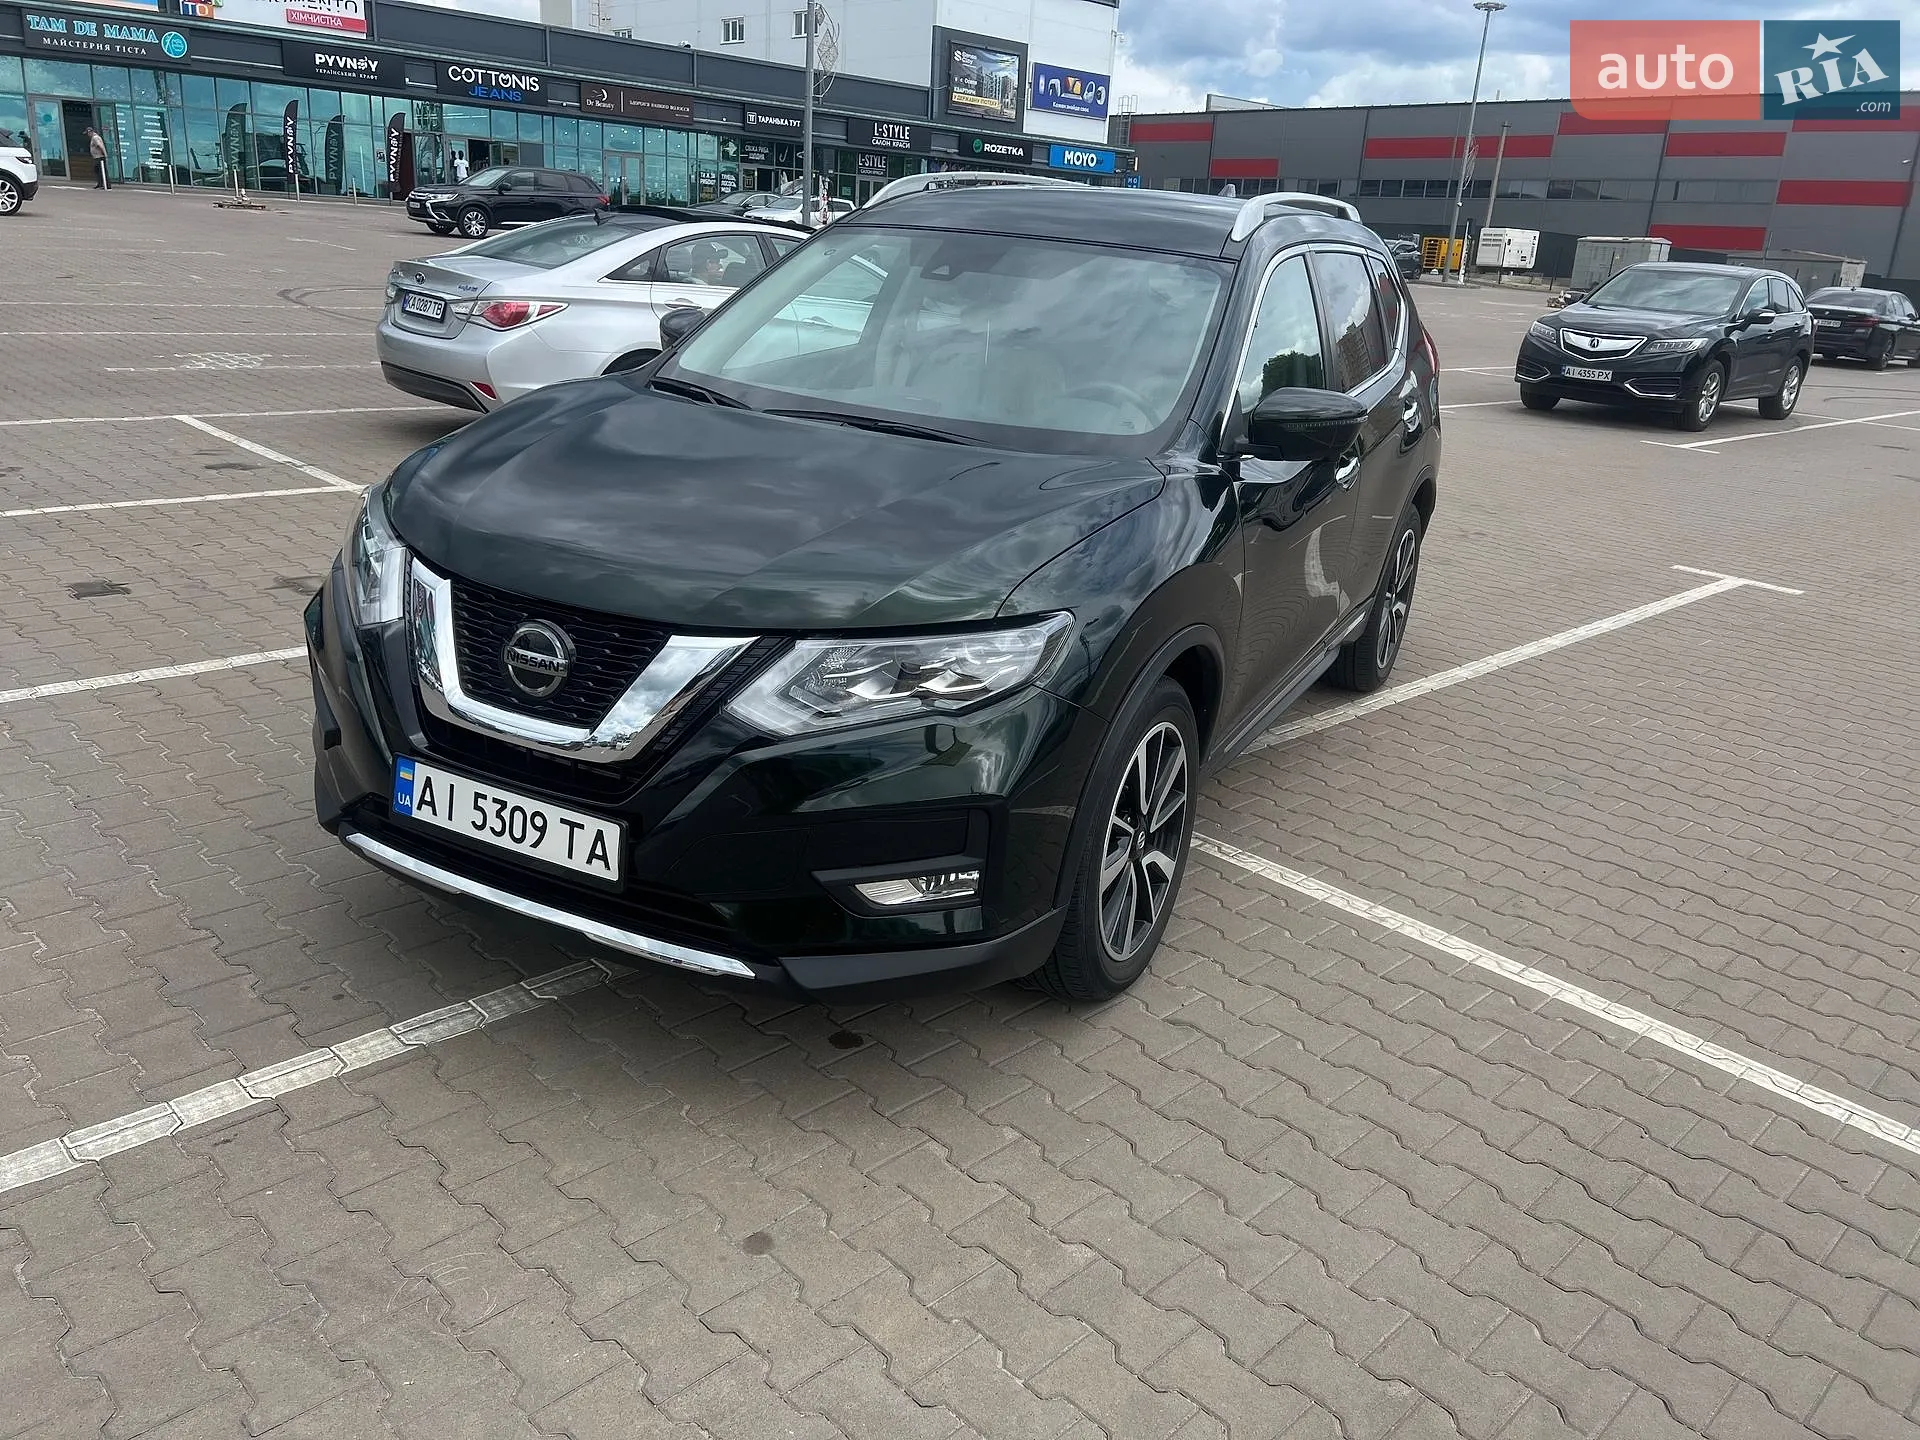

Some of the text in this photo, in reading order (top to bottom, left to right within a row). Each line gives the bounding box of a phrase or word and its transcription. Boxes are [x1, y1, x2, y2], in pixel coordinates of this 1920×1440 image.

[291, 11, 343, 27] ХІМЧИСТКА
[26, 14, 159, 43] TAM DE MAMA
[43, 37, 147, 55] МАЙСТЕРНЯ ТІСТА
[448, 65, 540, 92] COTTONIS
[469, 85, 522, 102] JEANS
[586, 98, 594, 106] Dr
[758, 115, 801, 127] ТАРАНЬКА ТУТ
[874, 122, 910, 140] L-STYLE
[871, 138, 911, 149] САЛОН КРАСИ
[984, 143, 1024, 157] ROZETKA
[858, 153, 887, 168] L-STYLE
[1063, 150, 1097, 168] MOYO
[1578, 368, 1597, 378] 4355
[1597, 371, 1611, 380] PX
[506, 648, 560, 672] NISSAN
[397, 792, 411, 808] UA
[416, 775, 612, 871] AI 5309 TA
